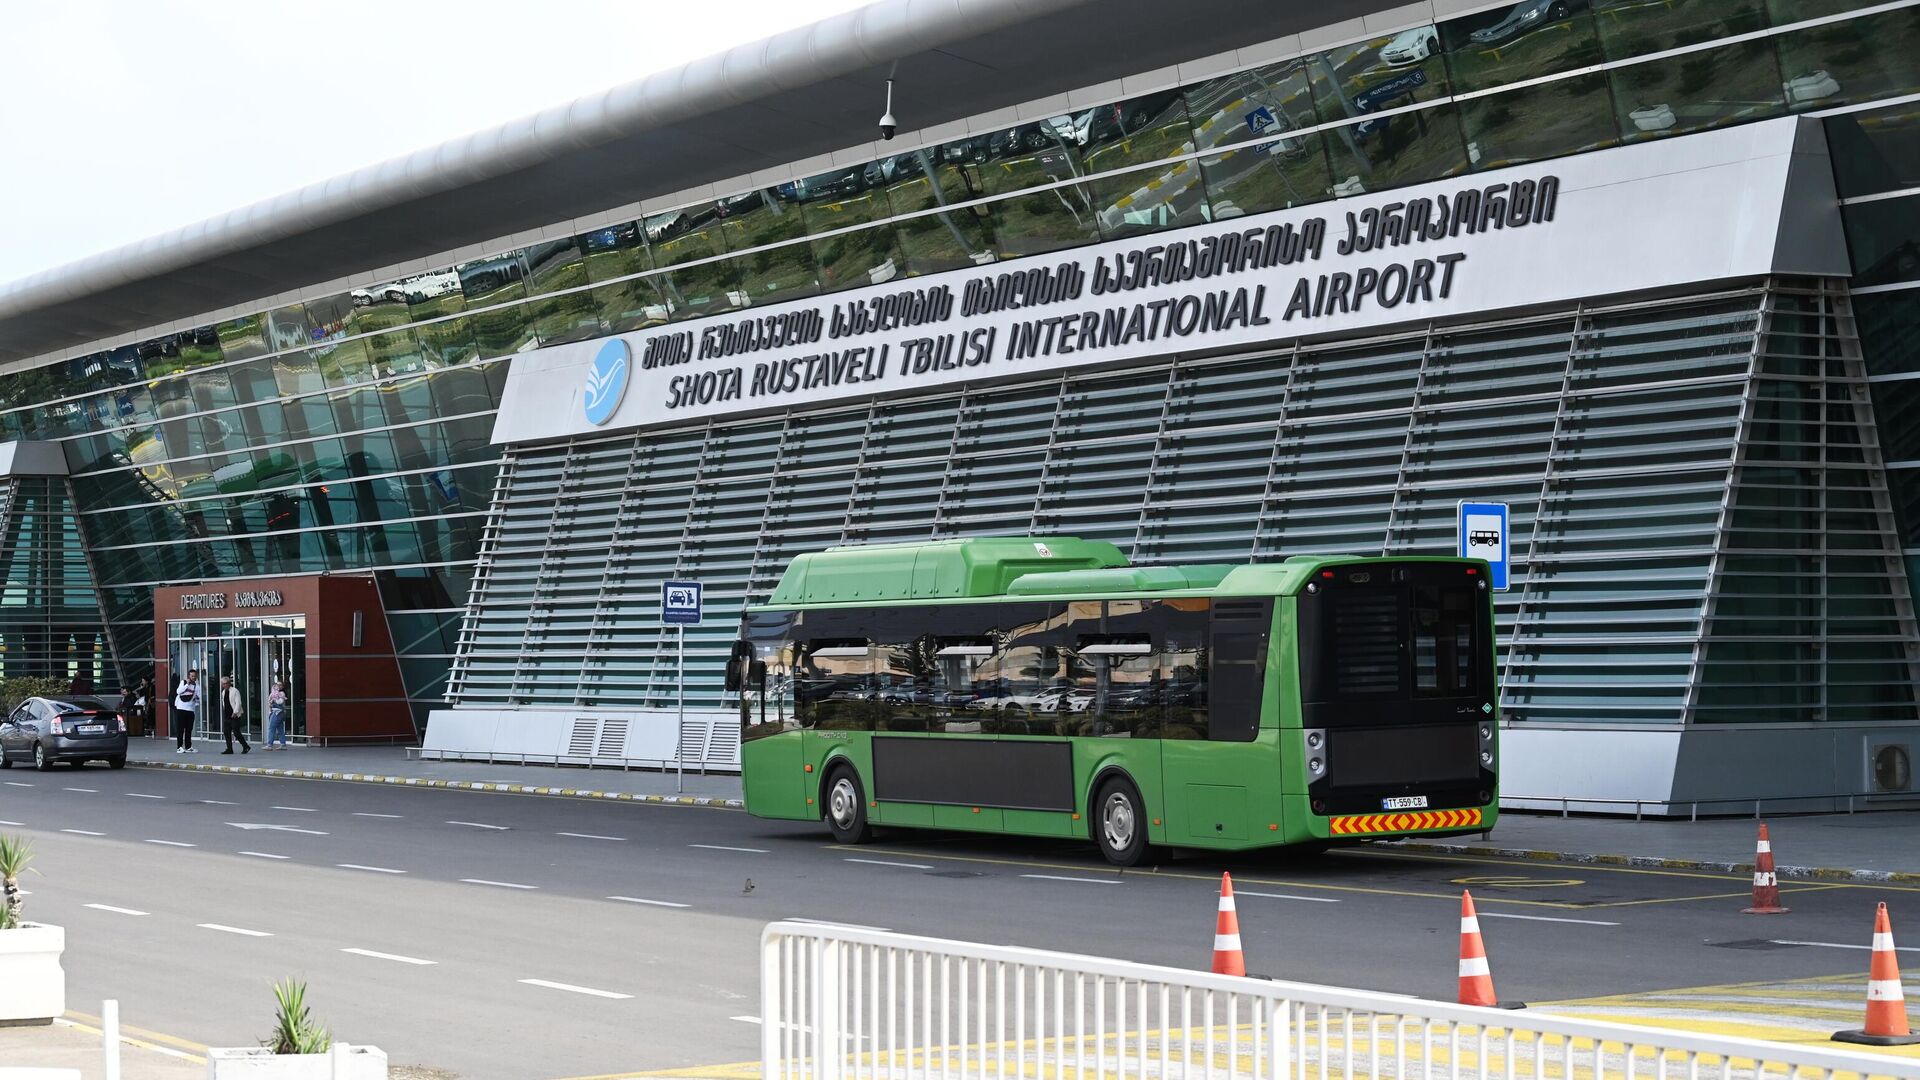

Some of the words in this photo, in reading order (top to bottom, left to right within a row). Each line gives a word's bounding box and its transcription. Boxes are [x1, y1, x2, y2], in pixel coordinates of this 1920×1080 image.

[641, 330, 693, 370] შოთა
[697, 306, 823, 361] რუსთაველის
[828, 284, 954, 339] სახელობის
[960, 260, 1085, 317] თბილისის
[1090, 216, 1326, 296] საერთაშორისო
[1337, 175, 1559, 256] აეროპორტი
[665, 367, 742, 409] SHOTA
[749, 343, 890, 397] RUSTAVELI
[899, 325, 997, 376] TBILISI
[1005, 283, 1270, 360] INTERNATIONAL
[1282, 252, 1467, 321] AIRPORT
[181, 593, 225, 610] DEPARTURES
[1388, 797, 1423, 808] TT-559-CB
